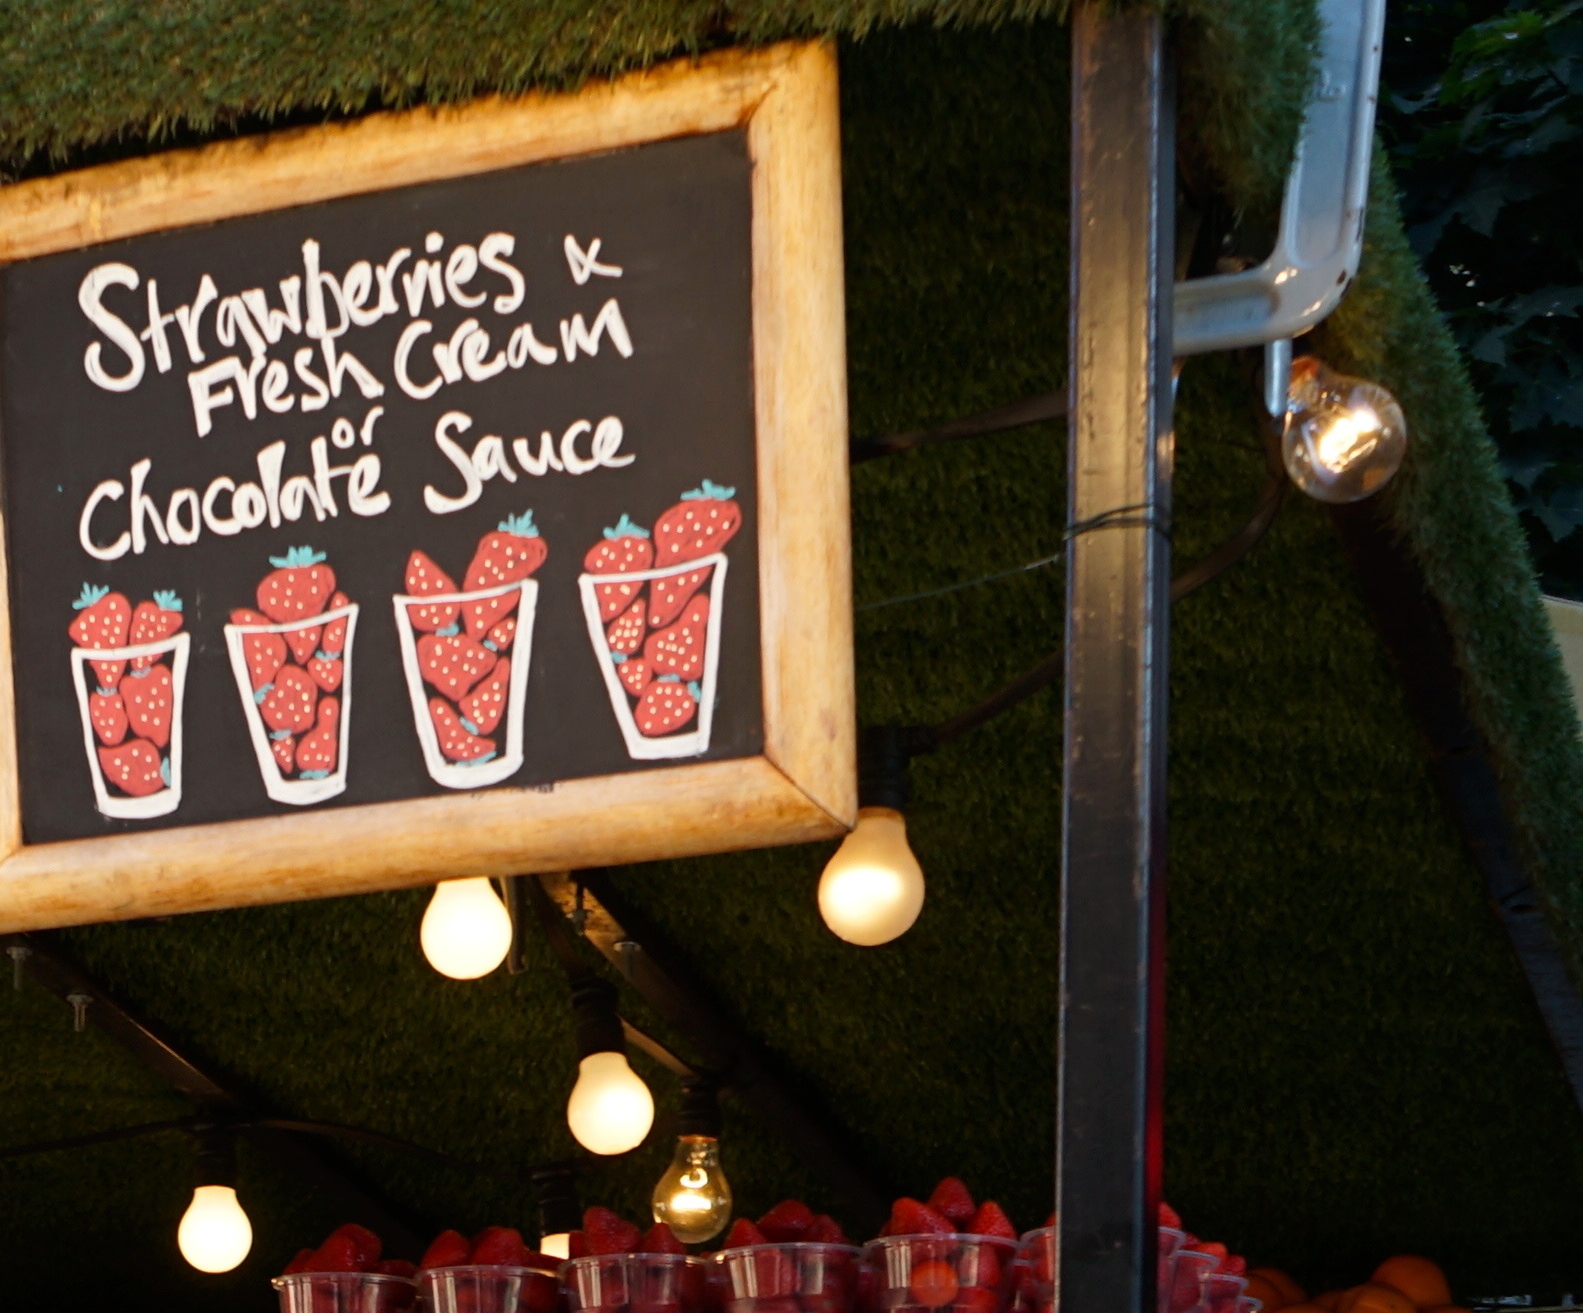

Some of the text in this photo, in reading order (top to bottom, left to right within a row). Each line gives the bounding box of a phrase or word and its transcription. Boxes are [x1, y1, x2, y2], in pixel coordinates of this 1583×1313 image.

[78, 231, 527, 393] Strawberries
[189, 299, 635, 436] Fresh Cream
[78, 411, 637, 560] Chocolate Sauce
[329, 407, 384, 451] or
